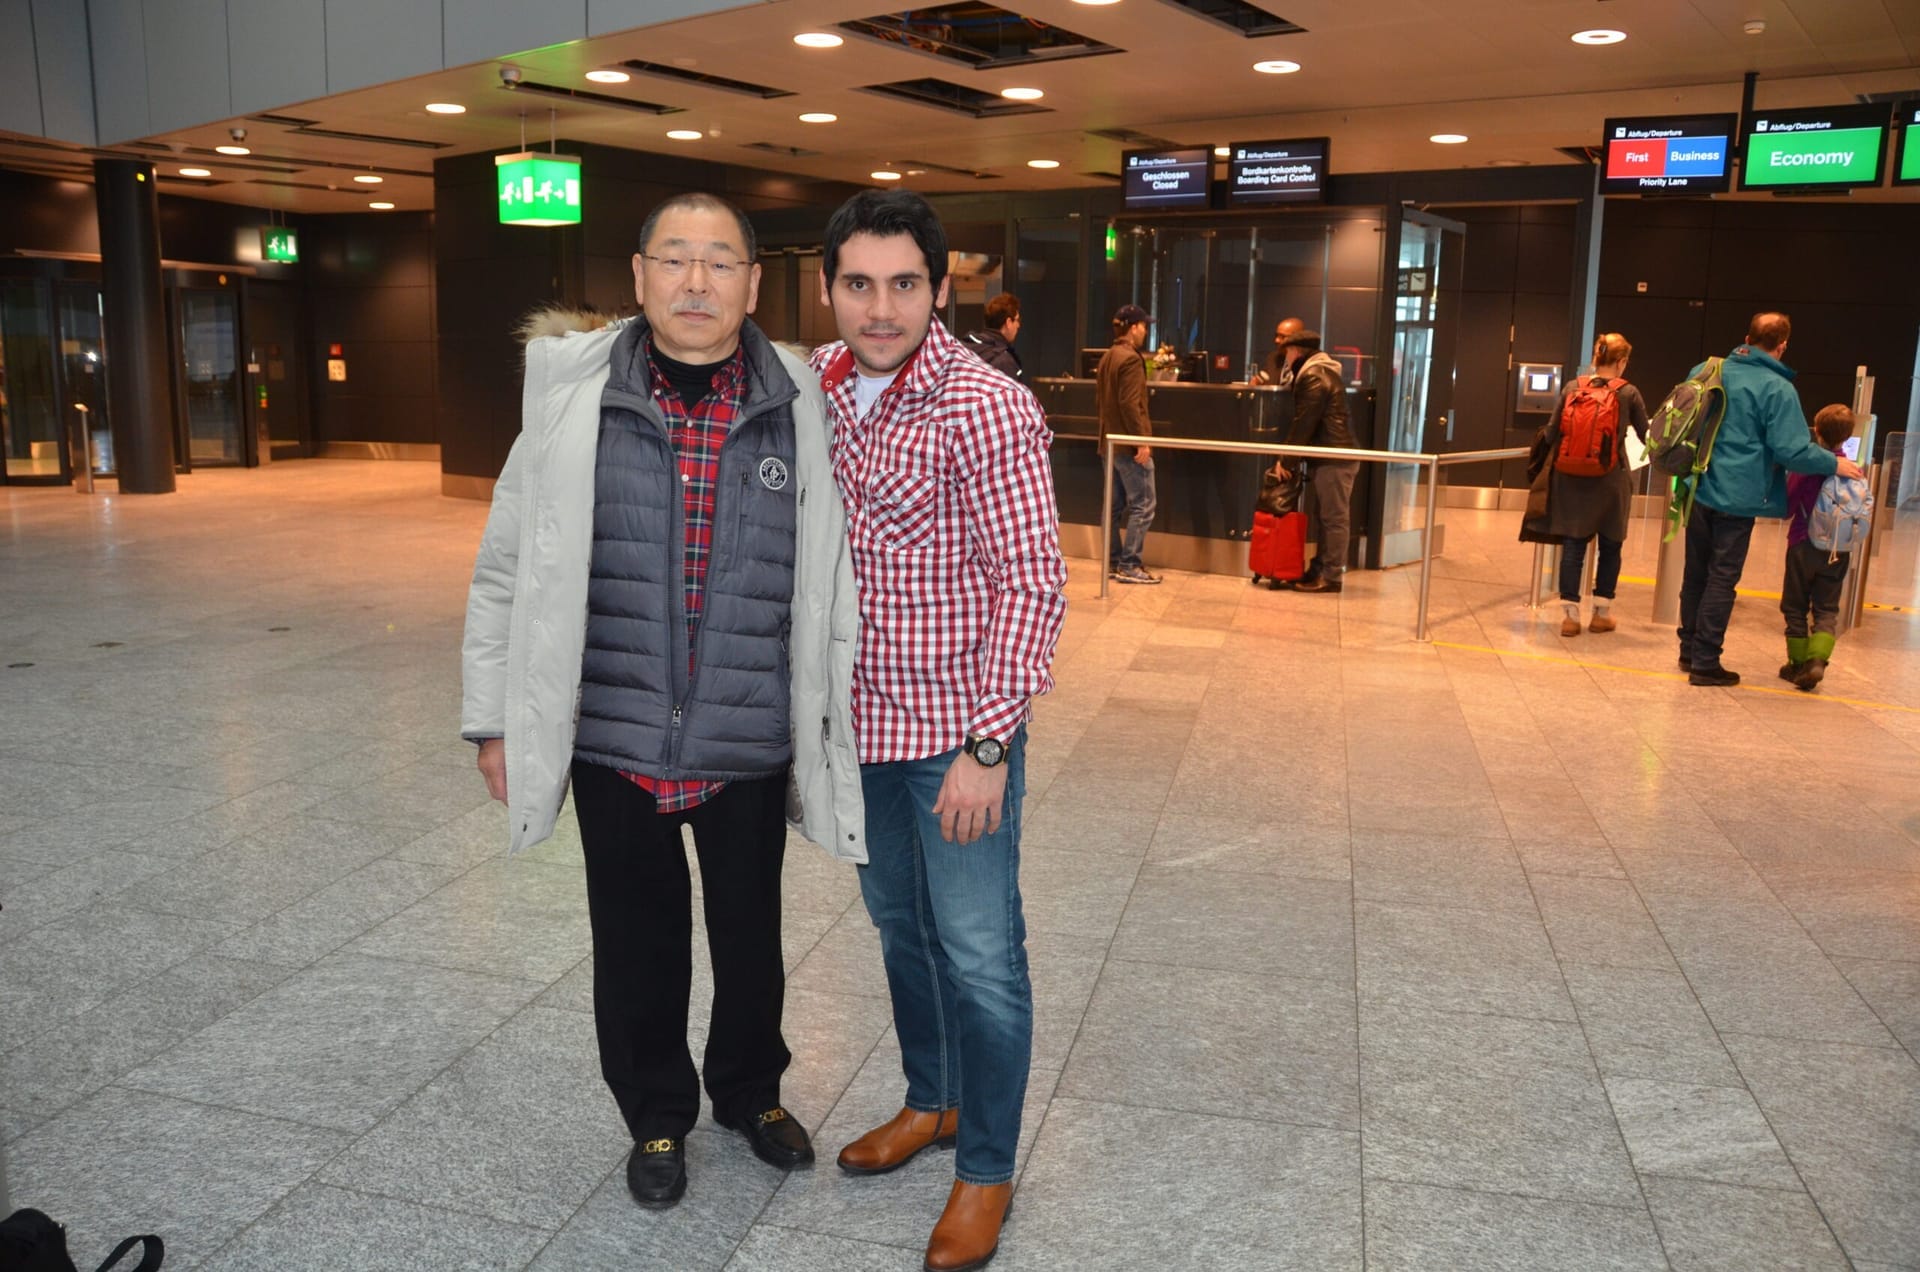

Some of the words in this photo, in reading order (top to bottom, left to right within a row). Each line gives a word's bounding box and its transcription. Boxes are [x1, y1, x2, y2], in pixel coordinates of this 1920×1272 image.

[1625, 152, 1649, 163] First
[1670, 151, 1719, 162] Business
[1770, 150, 1854, 166] Economy
[1242, 165, 1312, 175] Bordkartenkontrolle
[1142, 171, 1190, 182] Geschlossen
[1237, 175, 1269, 185] Boarding
[1270, 175, 1289, 184] Card
[1289, 173, 1316, 182] Control
[1152, 180, 1179, 190] Closed
[1639, 178, 1668, 188] Priority
[1667, 177, 1688, 186] Lane
